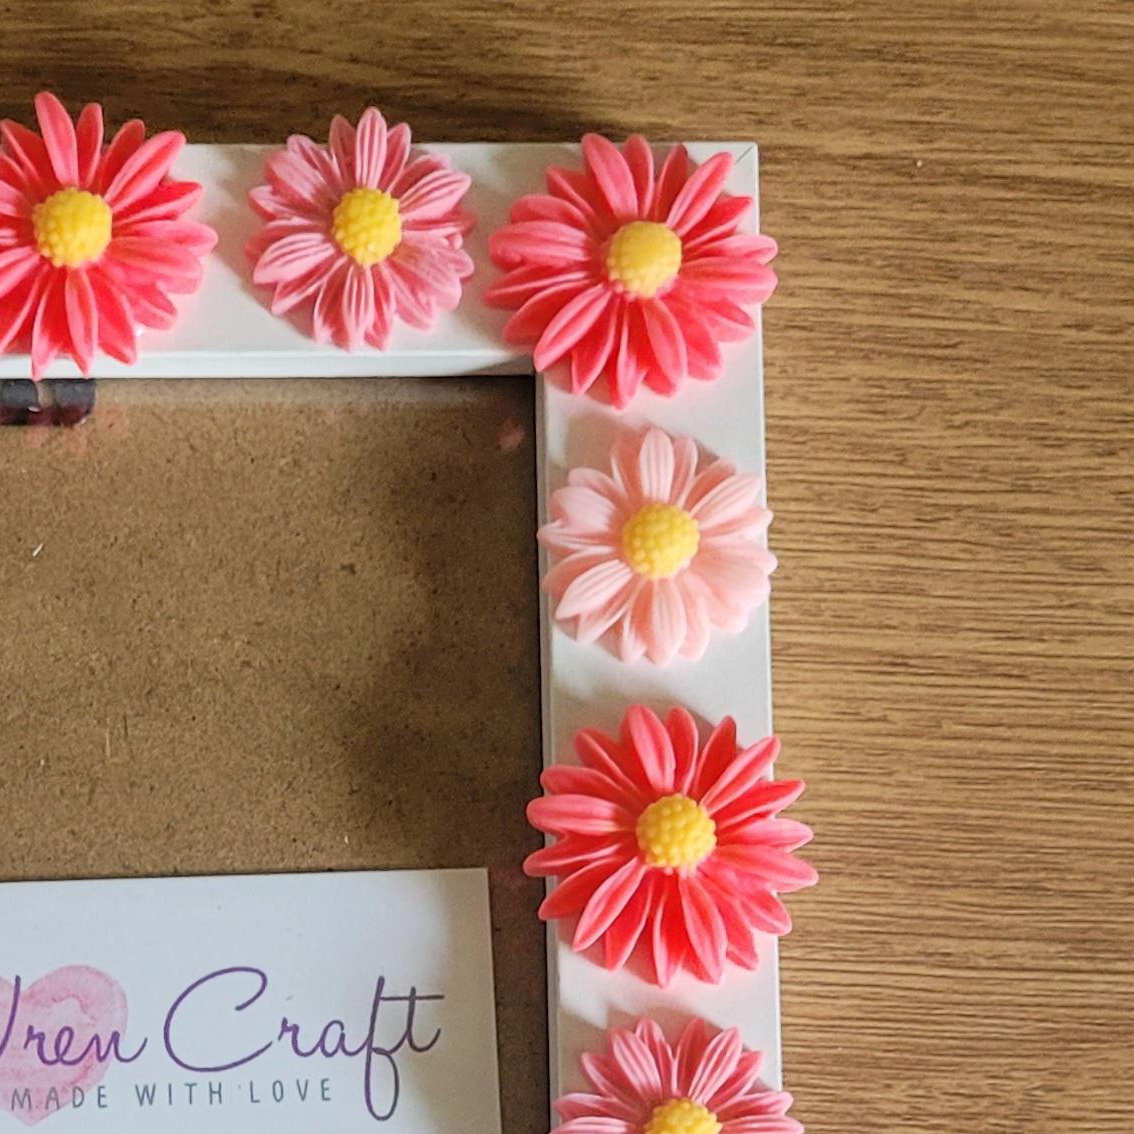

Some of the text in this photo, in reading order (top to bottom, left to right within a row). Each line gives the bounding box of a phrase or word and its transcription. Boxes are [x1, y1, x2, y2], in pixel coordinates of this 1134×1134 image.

[163, 966, 445, 1121] Craft
[134, 1081, 223, 1107] WITH
[248, 1078, 332, 1104] LOVE
